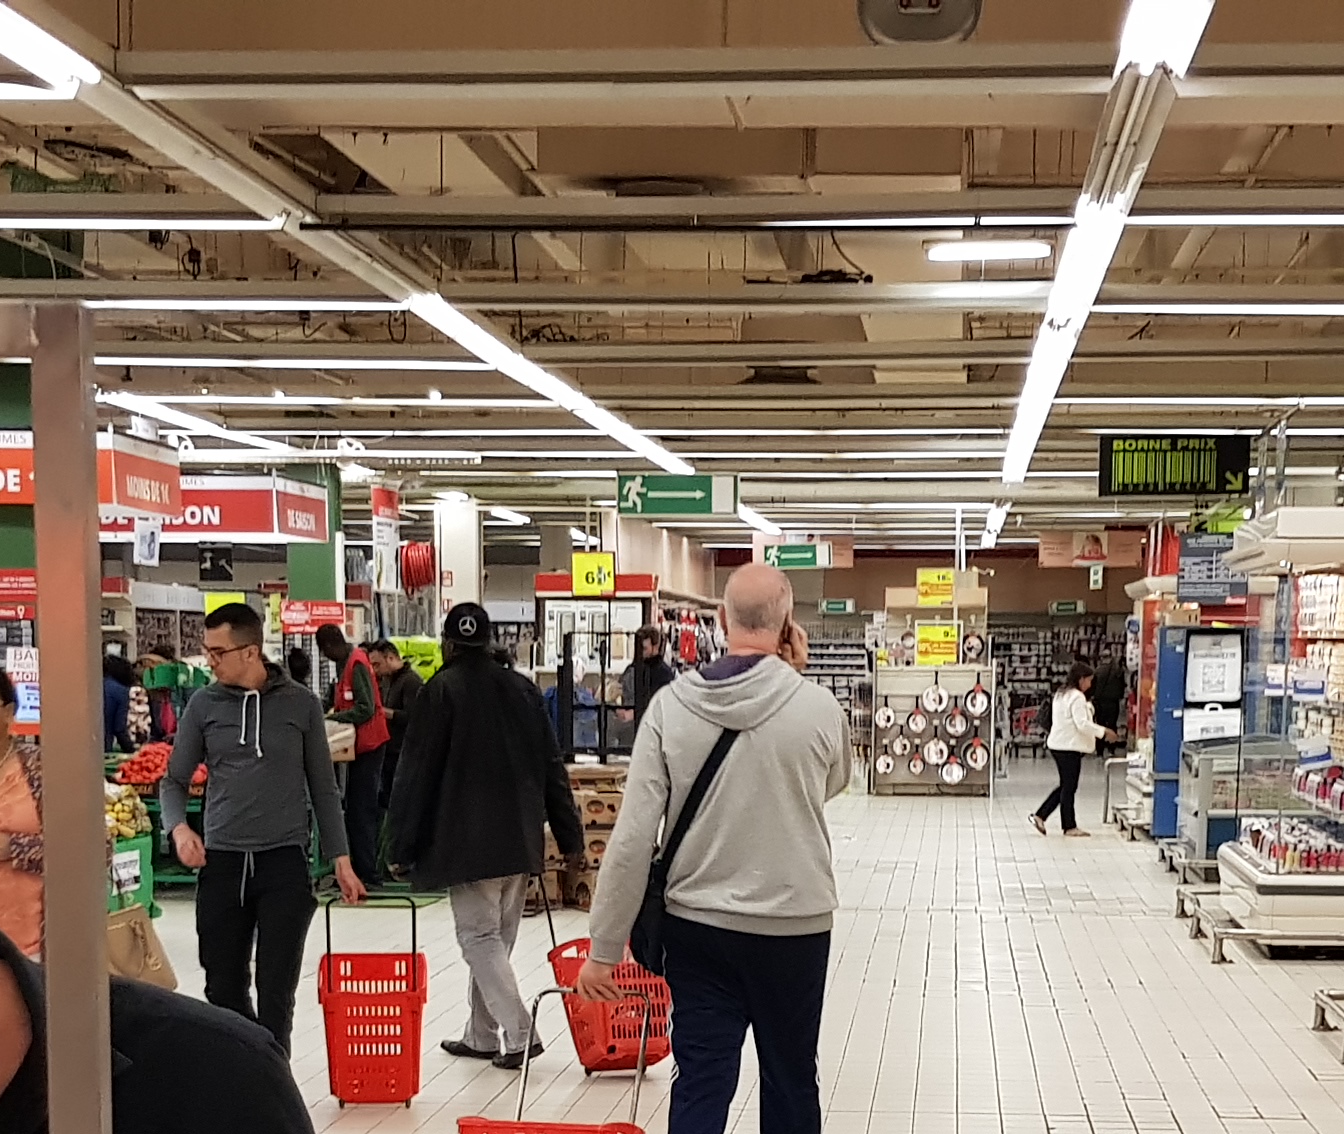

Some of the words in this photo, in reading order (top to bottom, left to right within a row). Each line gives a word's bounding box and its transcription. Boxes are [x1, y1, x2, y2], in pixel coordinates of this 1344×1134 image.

[1113, 439, 1172, 450] BORNE
[1177, 438, 1217, 450] PRIX
[126, 474, 152, 499] MOINS
[296, 510, 316, 531] SAISON
